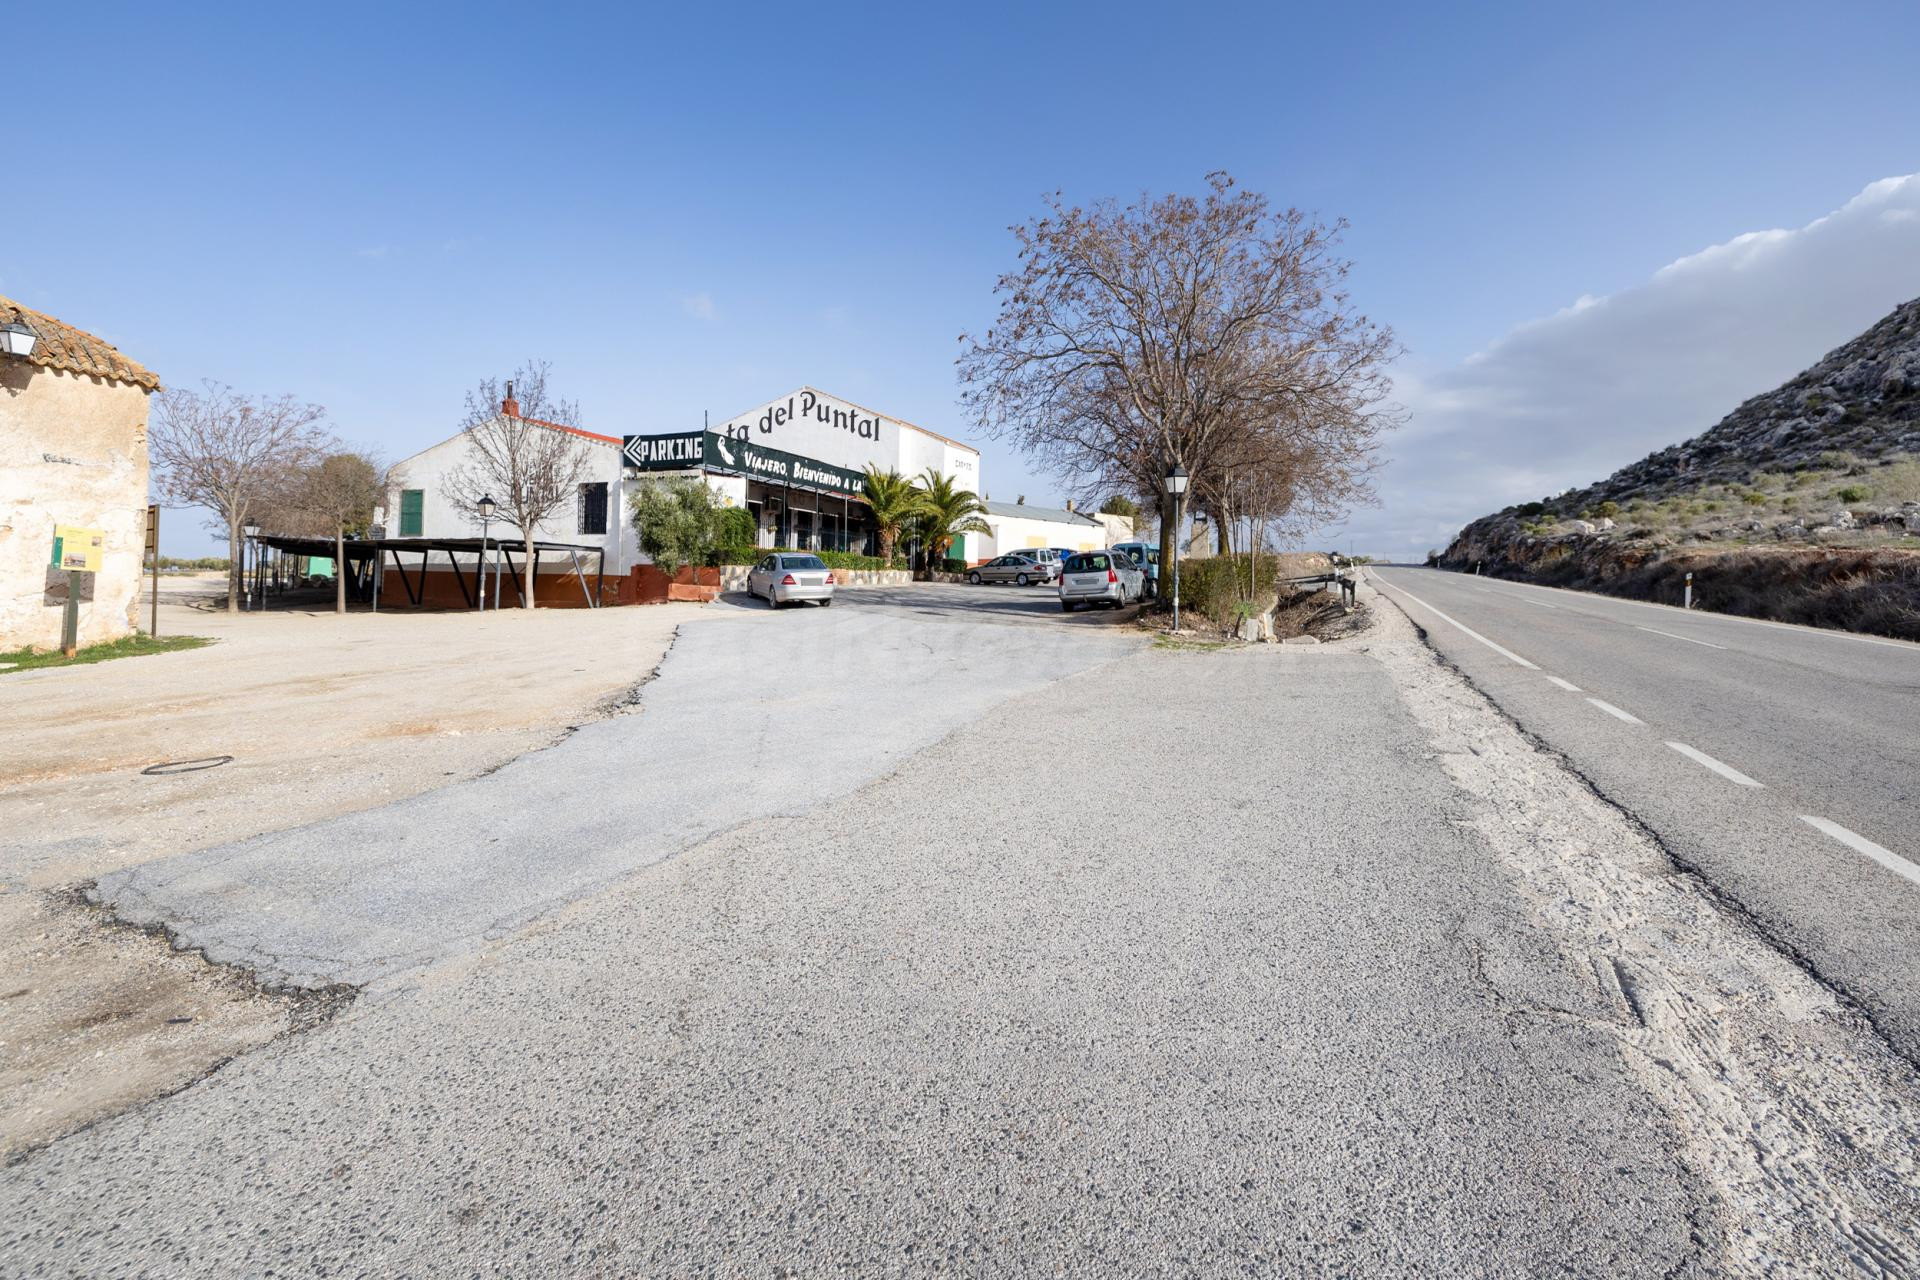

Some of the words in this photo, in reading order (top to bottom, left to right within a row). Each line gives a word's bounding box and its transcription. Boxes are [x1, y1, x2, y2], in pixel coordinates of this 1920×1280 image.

[759, 397, 794, 434] del
[800, 391, 880, 441] Puntal
[640, 437, 703, 461] PARKING
